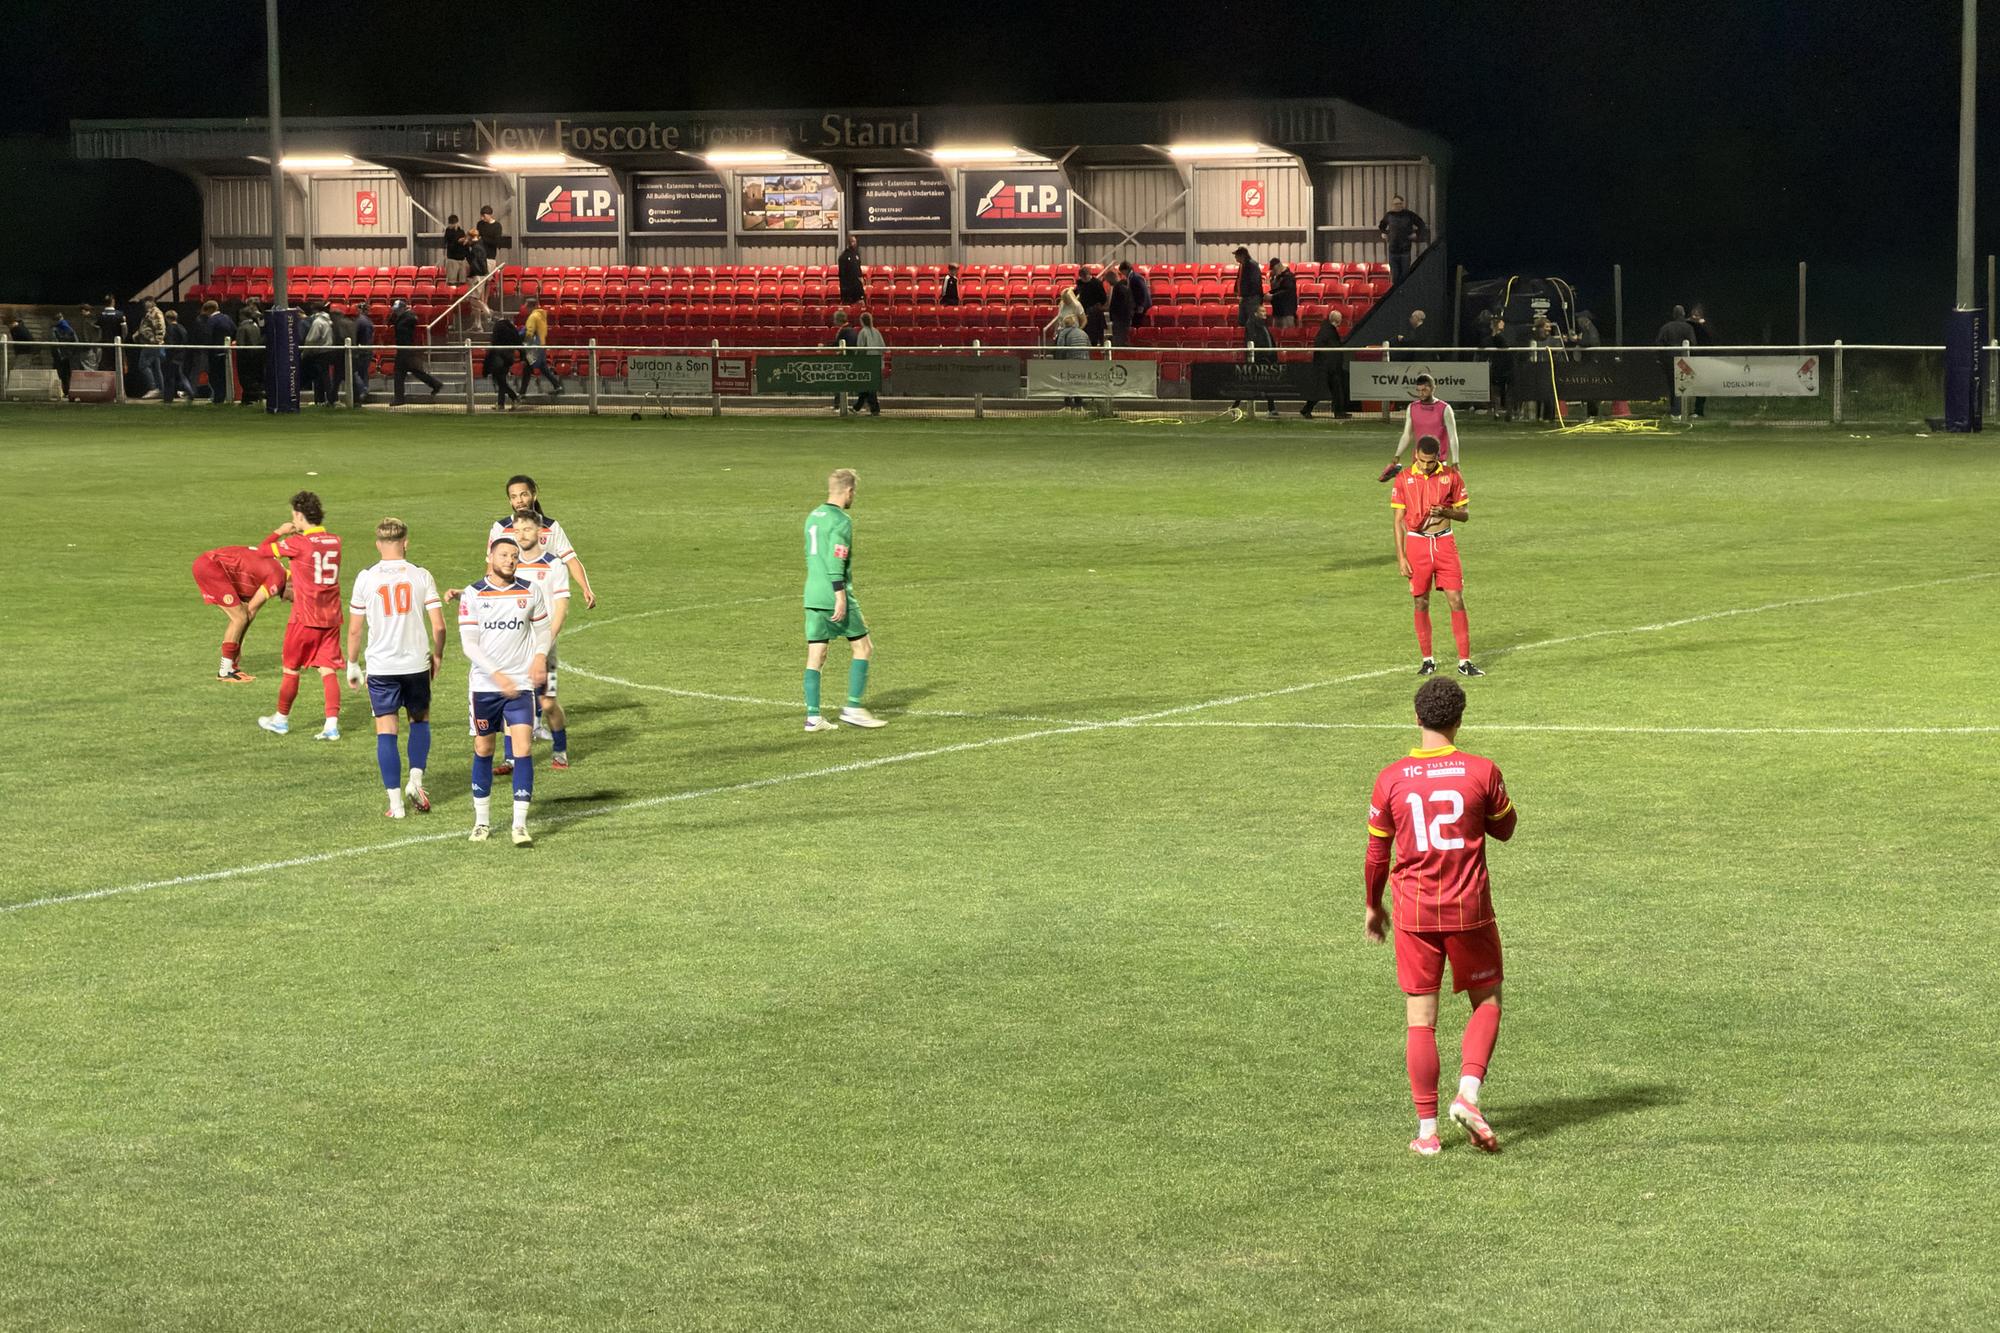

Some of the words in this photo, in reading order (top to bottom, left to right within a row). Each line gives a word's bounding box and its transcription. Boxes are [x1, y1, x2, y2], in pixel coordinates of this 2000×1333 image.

[423, 128, 461, 149] THE
[473, 118, 544, 151] New
[555, 118, 680, 151] Foscote
[822, 112, 919, 147] Stand
[571, 190, 616, 216] T.P.
[874, 190, 897, 198] Building
[1015, 185, 1062, 212] T.P.
[630, 359, 672, 371] Jordon
[675, 361, 683, 371] &
[686, 359, 709, 371] Son
[787, 361, 853, 373] KARPET
[1235, 364, 1288, 375] MORSE
[796, 370, 872, 383] KINGDOM
[1371, 375, 1399, 385] TCW
[1401, 375, 1466, 386] Auotive
[808, 524, 818, 555] 1
[312, 550, 339, 585] 15
[375, 581, 413, 617] 10
[1427, 761, 1465, 769] TUSTAIN
[1405, 789, 1465, 852] 12
